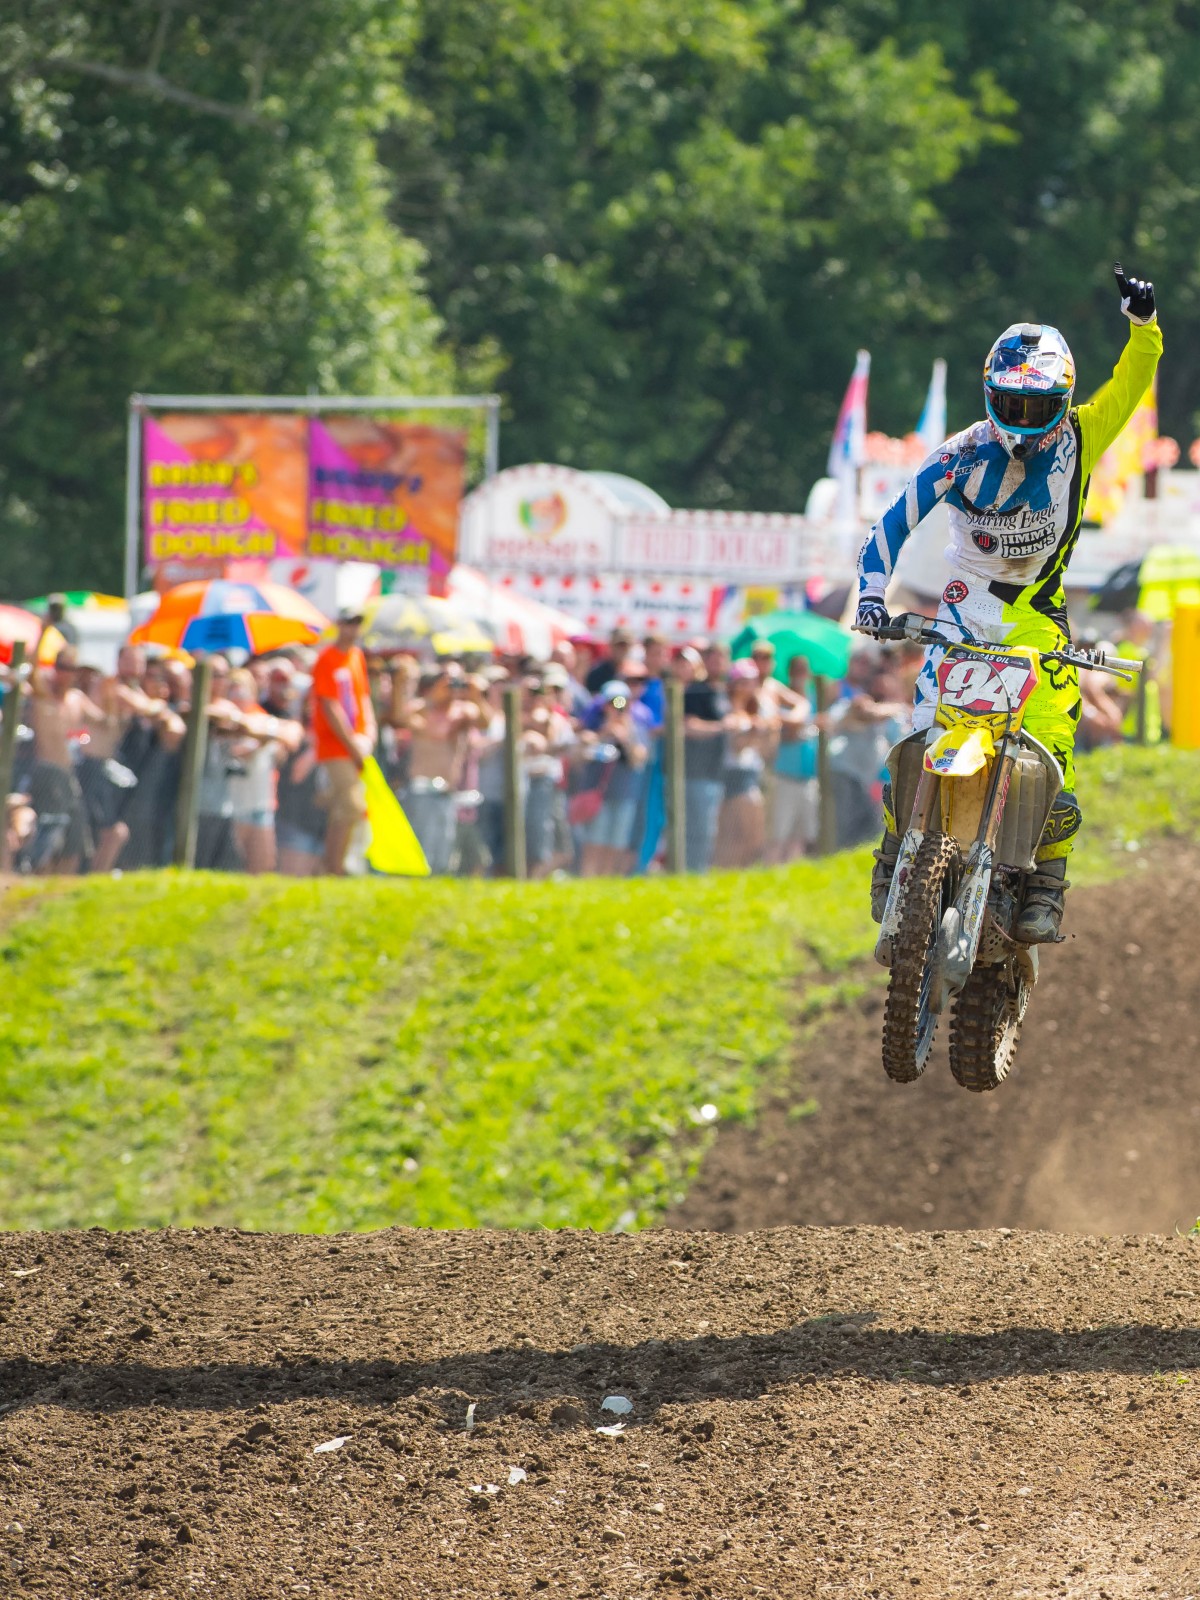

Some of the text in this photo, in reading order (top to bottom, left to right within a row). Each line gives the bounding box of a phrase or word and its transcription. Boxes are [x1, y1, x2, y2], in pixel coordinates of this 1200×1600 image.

[998, 376, 1048, 389] Red Bull
[966, 502, 1059, 530] Soaring Eagle
[1000, 522, 1055, 545] JIMMY
[1001, 533, 1056, 558] JOHN'S
[941, 660, 1031, 712] 94
